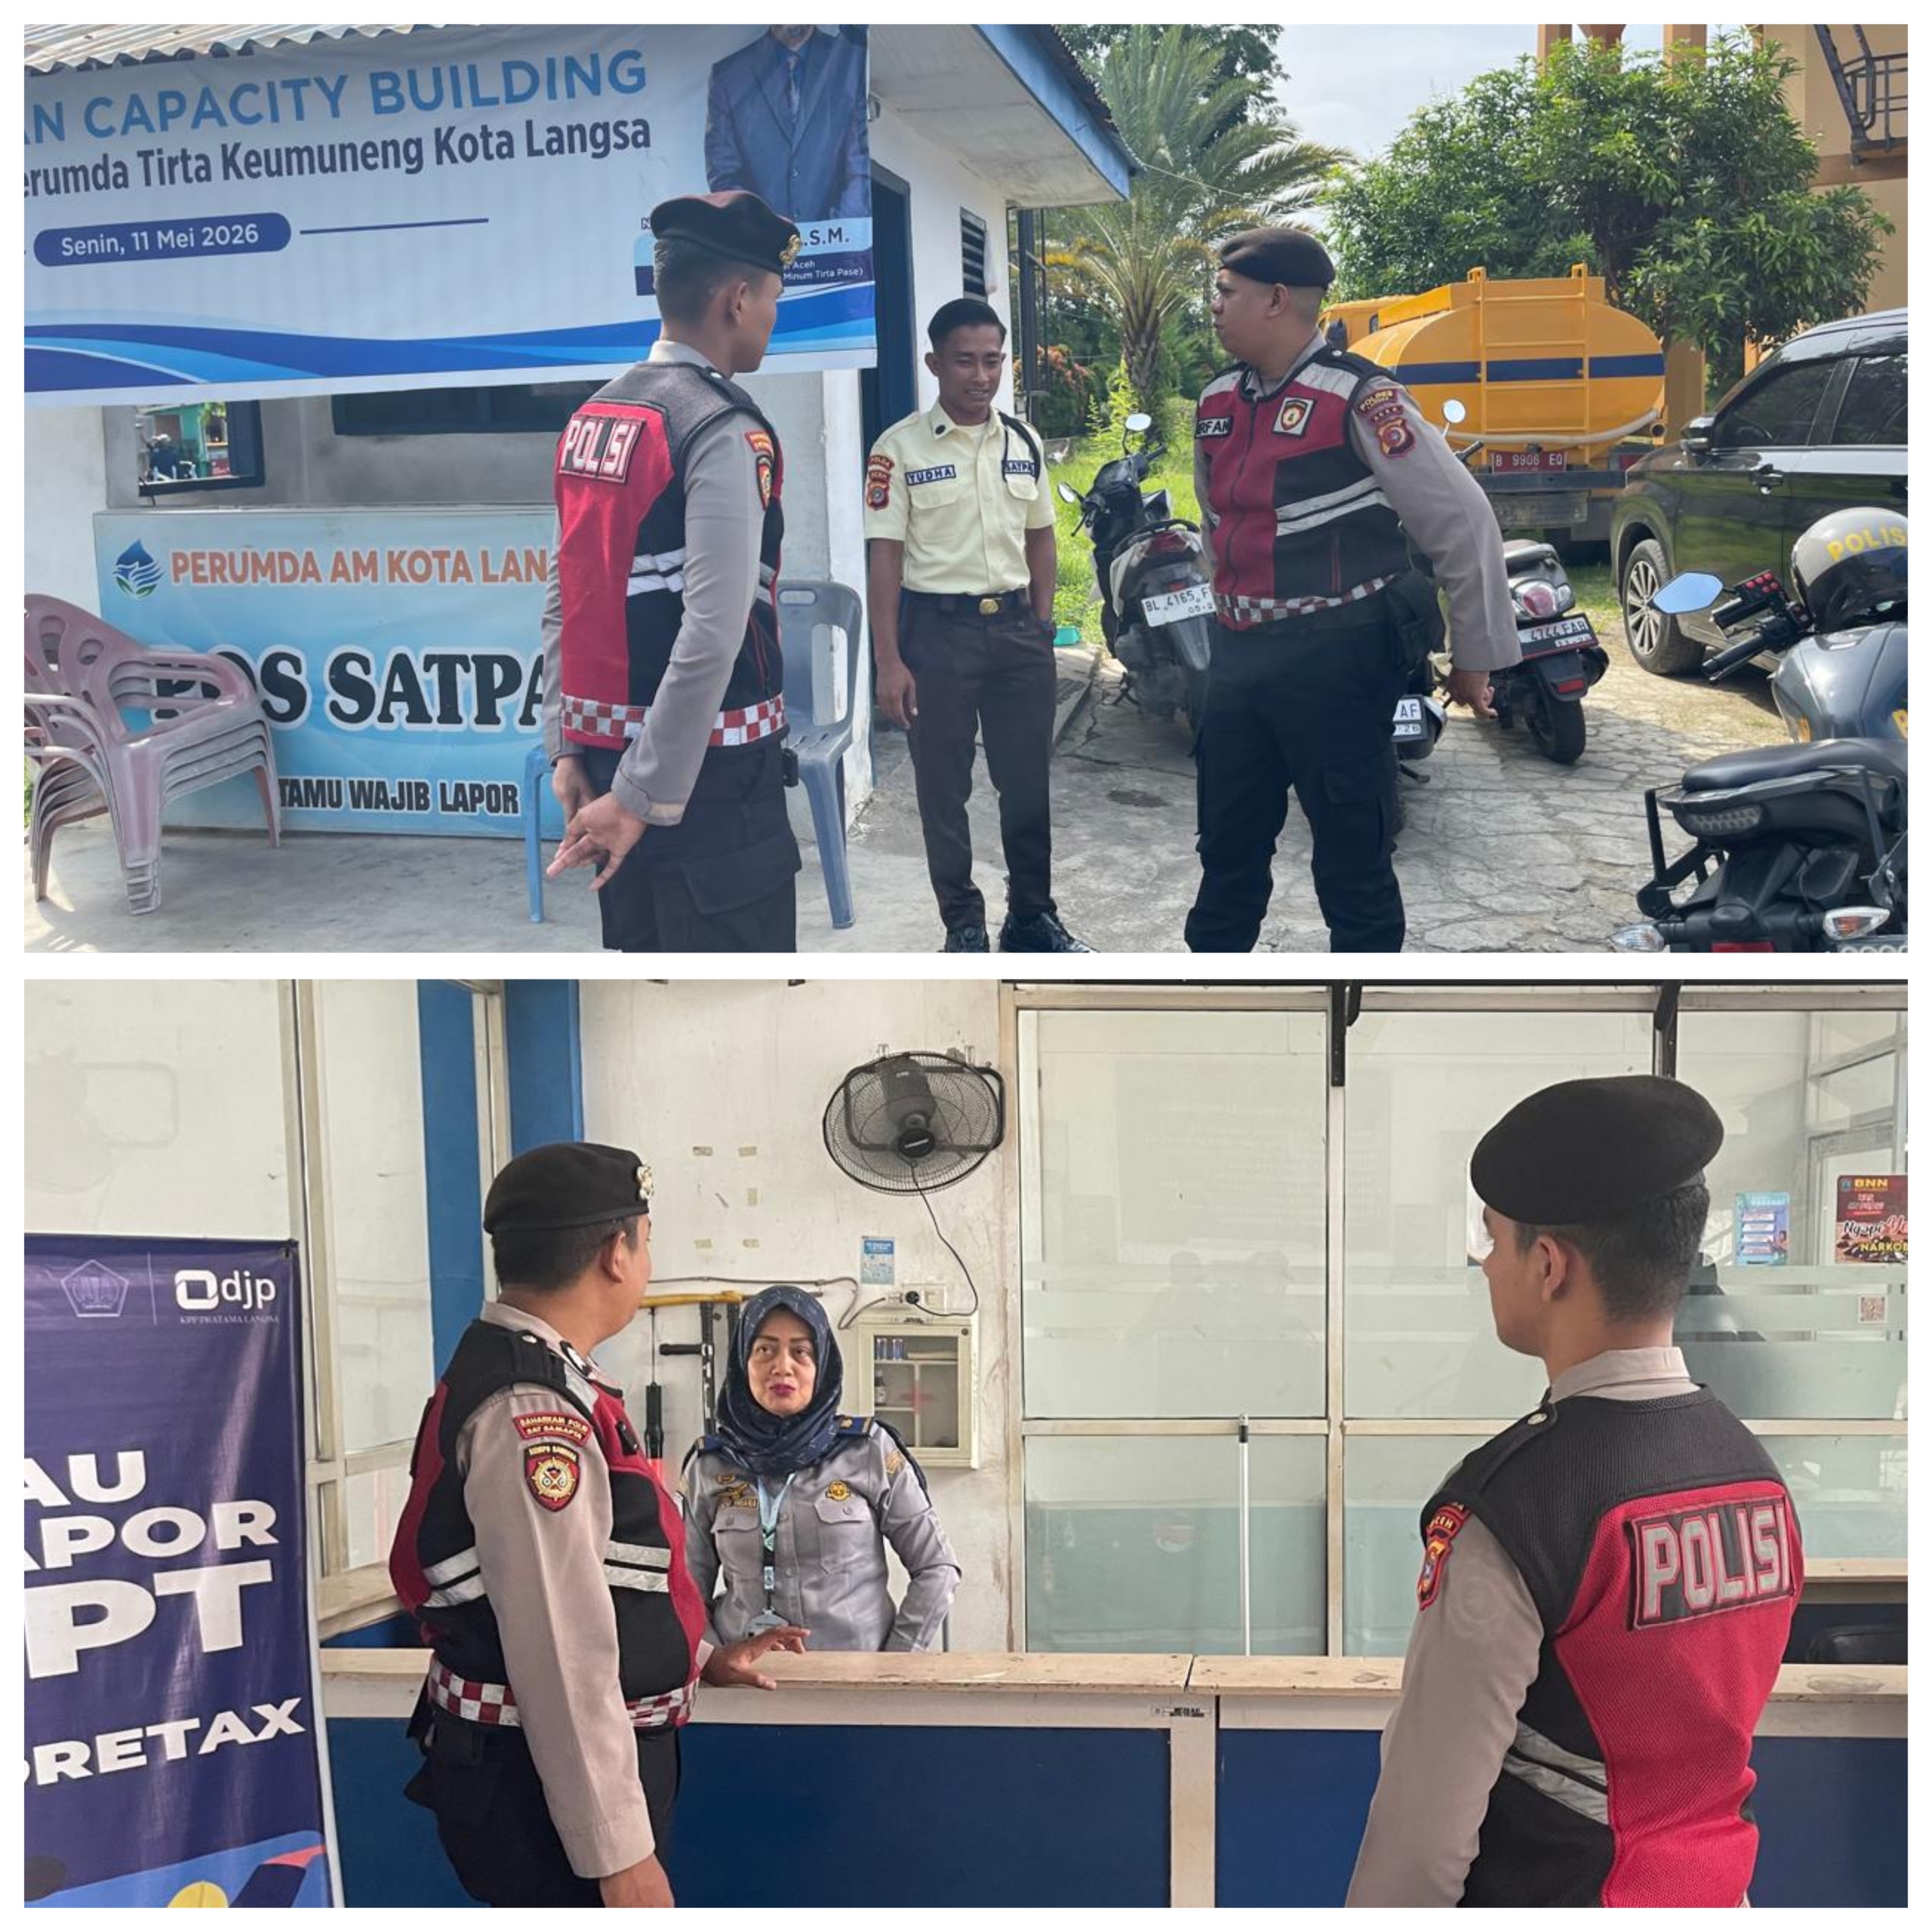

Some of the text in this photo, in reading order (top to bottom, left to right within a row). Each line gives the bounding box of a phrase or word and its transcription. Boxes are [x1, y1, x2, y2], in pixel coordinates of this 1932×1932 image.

[24, 49, 647, 145] N CAPACITY BUILDING
[137, 146, 212, 187] Tirta
[221, 137, 423, 181] Keumuneng
[435, 124, 515, 165] Kota
[526, 118, 651, 158] Langsa
[61, 224, 259, 257] Senin, 11 Mei 2026
[816, 269, 835, 278] Tirta
[837, 267, 863, 276] Pase)
[561, 420, 638, 476] POLISI
[908, 466, 953, 485] YUDHA
[171, 550, 322, 584] PERUMDA
[329, 550, 378, 584] AM
[388, 549, 475, 583] KOTA
[1145, 600, 1161, 612] BL
[1167, 589, 1195, 606] 4165
[278, 779, 519, 814] TAMU WAJIB LAPOR
[1854, 1179, 1888, 1188] BNN
[221, 1269, 276, 1309] djp
[24, 1499, 279, 1571] POR
[1641, 1501, 1791, 1620] POLISI
[24, 1698, 306, 1786] RETAX
